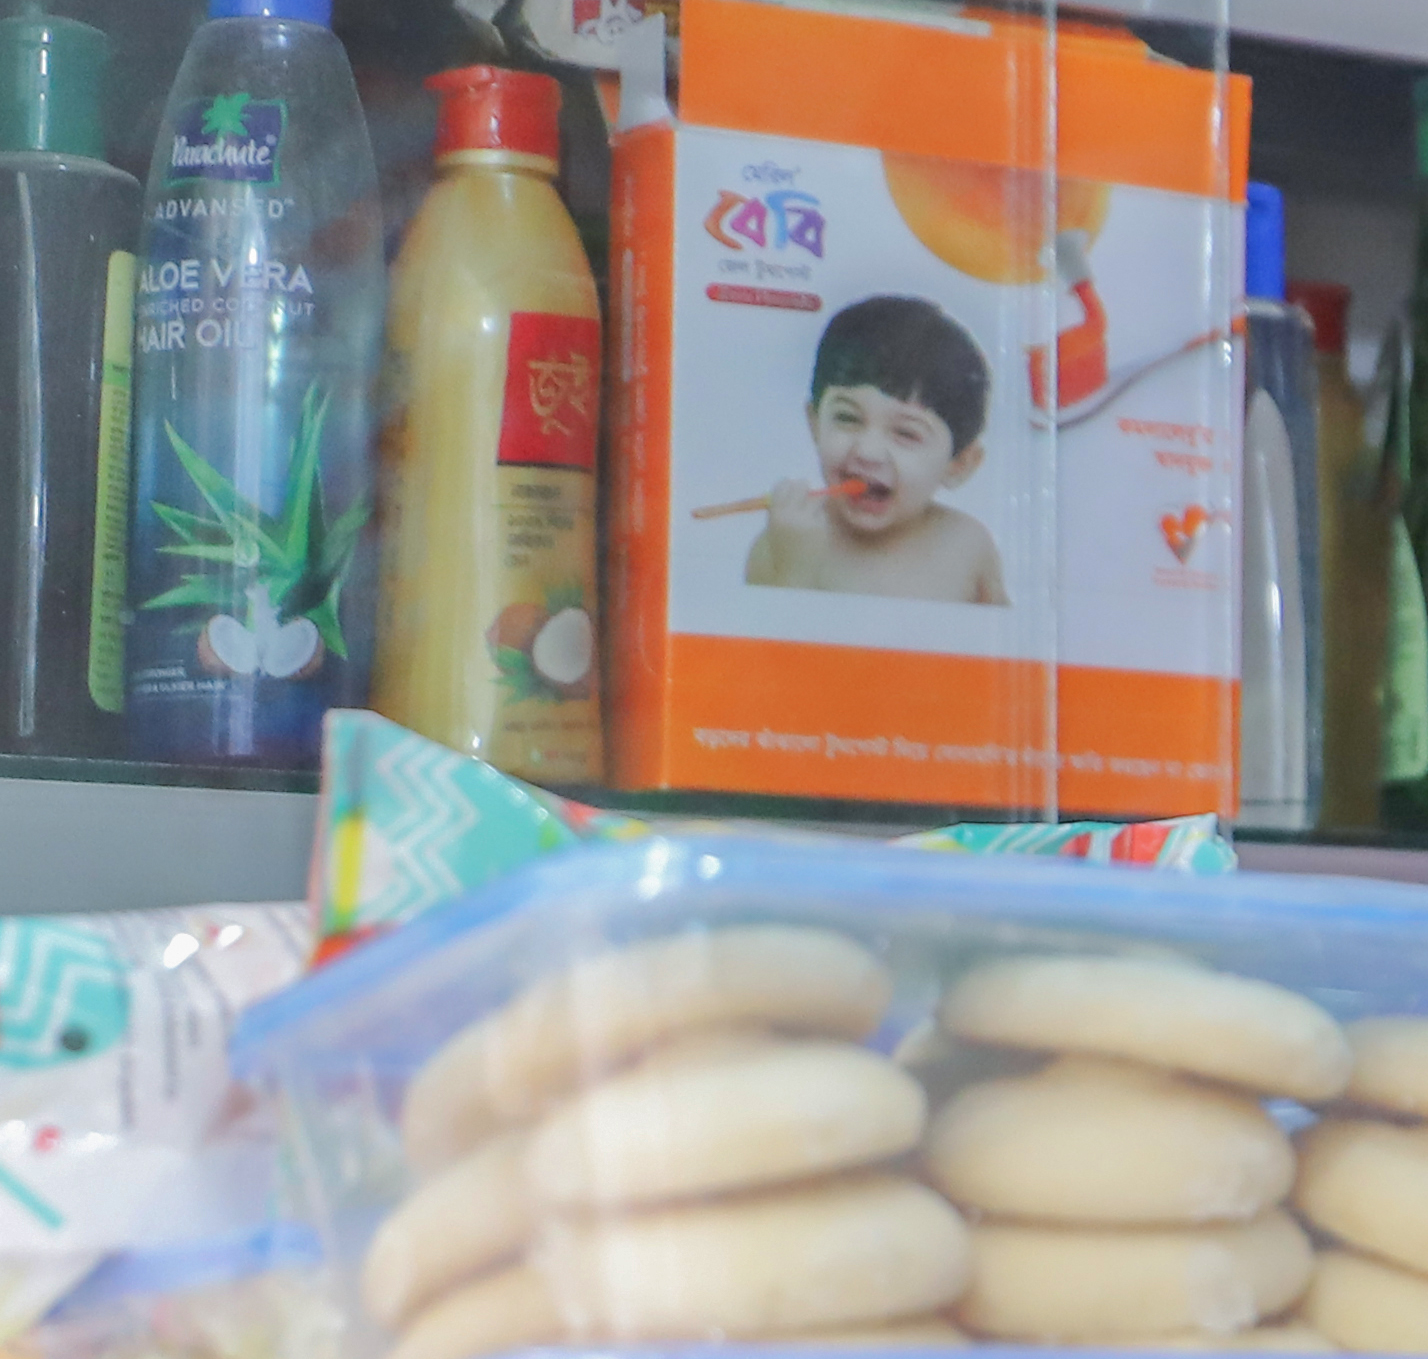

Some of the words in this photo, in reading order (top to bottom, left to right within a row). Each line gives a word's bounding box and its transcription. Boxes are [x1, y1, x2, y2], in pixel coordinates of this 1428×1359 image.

[171, 134, 272, 168] Parachute
[703, 188, 826, 260] বেবি
[140, 258, 200, 293] ALOE
[210, 257, 313, 294] VERA
[195, 318, 258, 347] OIL
